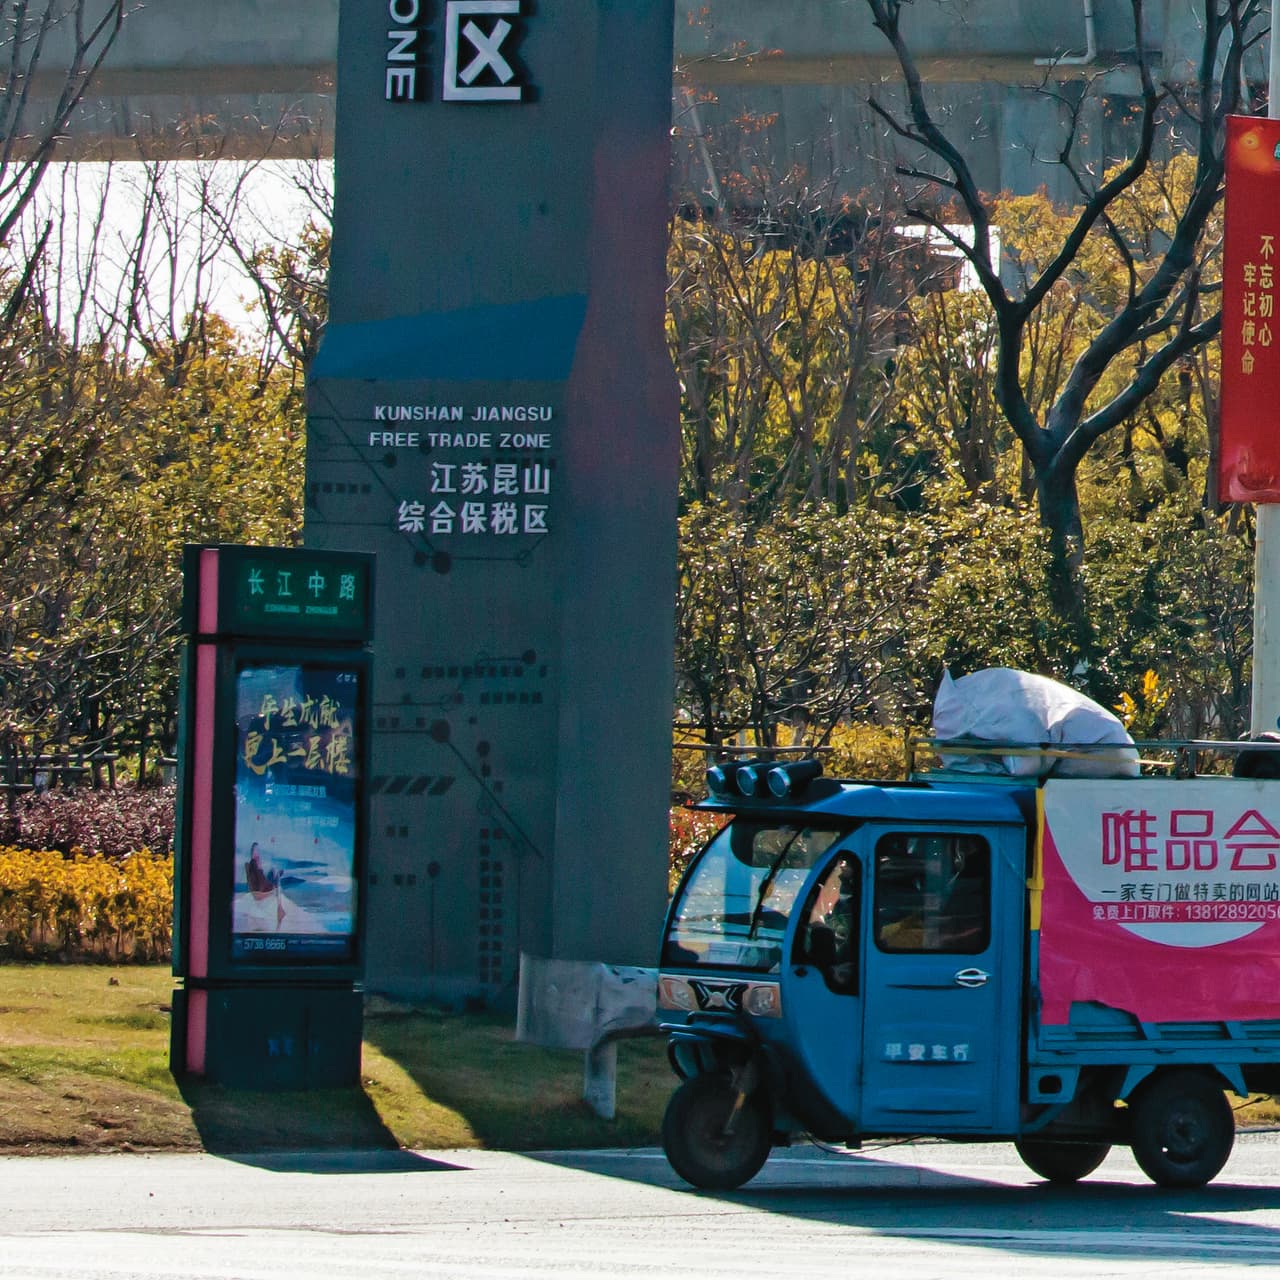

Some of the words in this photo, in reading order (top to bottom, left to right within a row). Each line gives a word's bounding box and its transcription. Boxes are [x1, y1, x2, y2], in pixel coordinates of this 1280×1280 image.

[1258, 235, 1275, 347] 不忘初心
[1241, 261, 1257, 376] 牢记使命
[374, 405, 464, 422] KUNSHAN
[471, 406, 553, 422] JIANGSU
[369, 432, 420, 448] FREE
[428, 432, 492, 448] TRADE
[499, 433, 552, 449] ZONE
[430, 461, 551, 495] 江苏昆山
[398, 500, 549, 535] 综合保税区
[247, 568, 356, 601] 长江中路
[1101, 883, 1280, 902] 一家专门做特卖的网站
